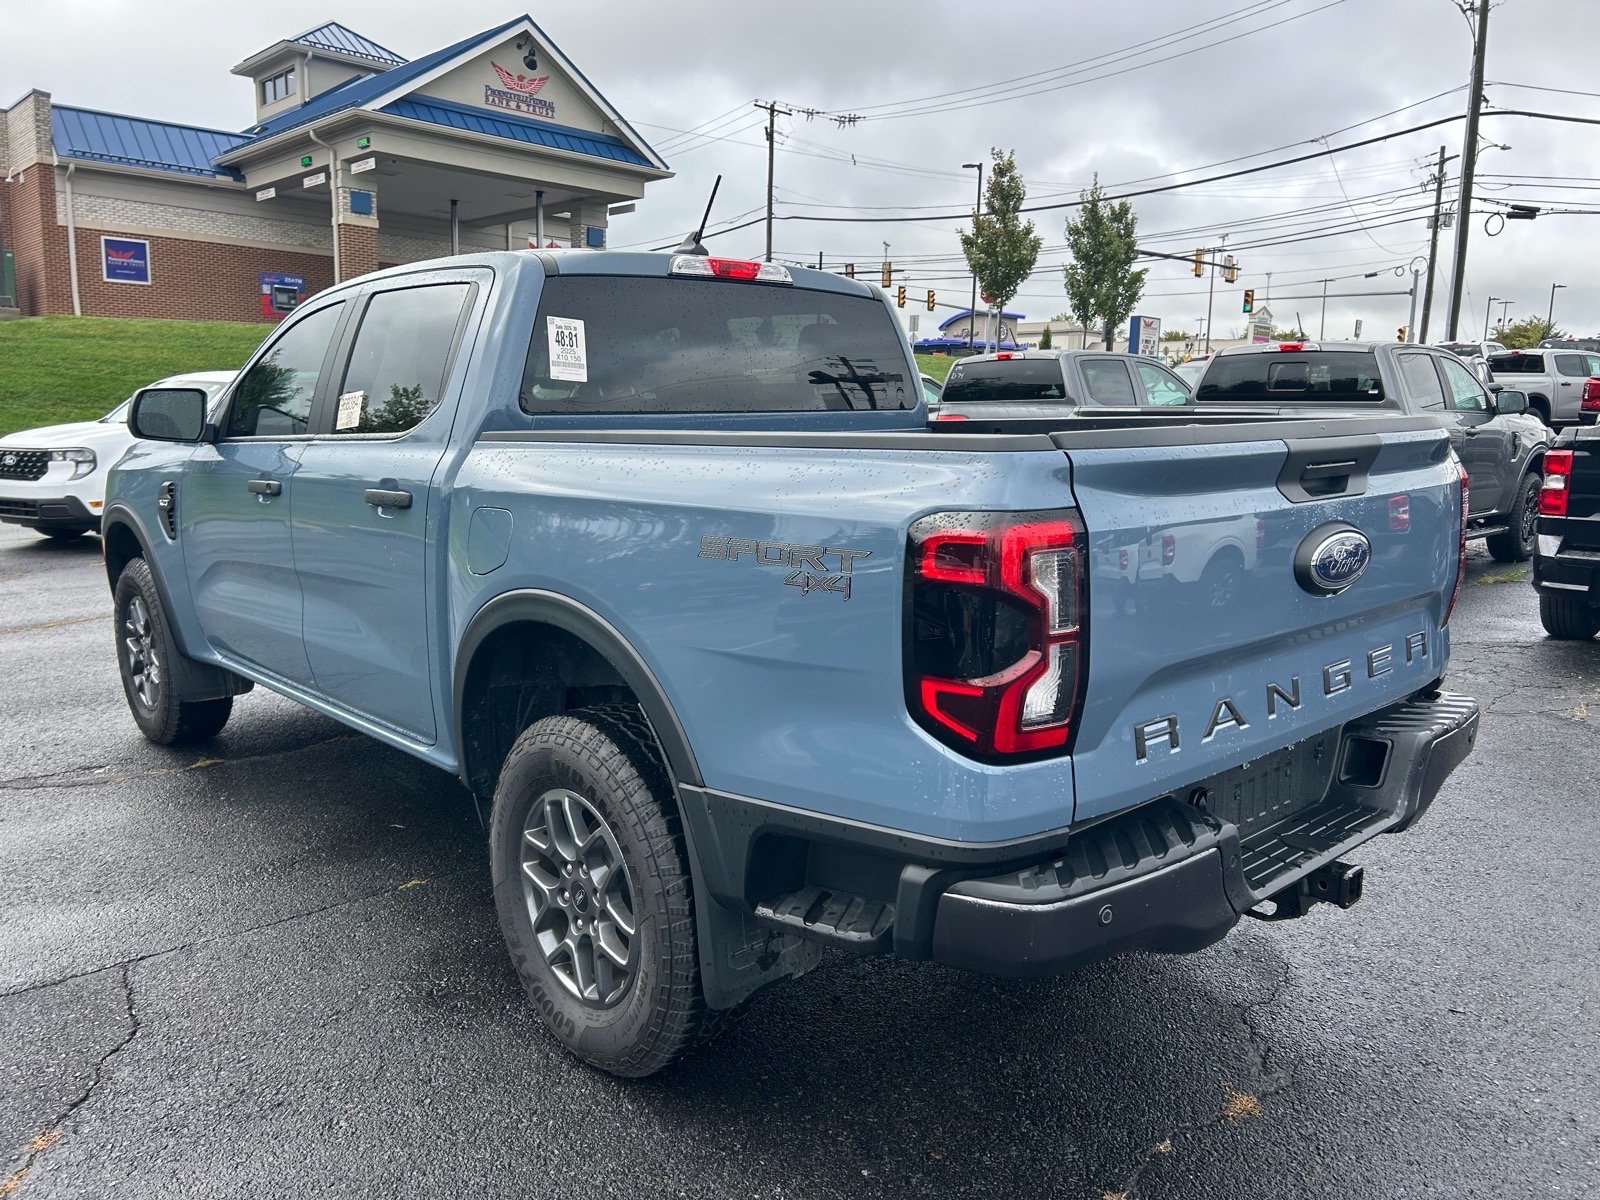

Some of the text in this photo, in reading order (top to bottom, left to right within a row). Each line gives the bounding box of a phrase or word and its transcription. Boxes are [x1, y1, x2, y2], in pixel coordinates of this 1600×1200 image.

[485, 96, 511, 107] BANK
[527, 104, 555, 116] TRUST
[555, 330, 578, 348] 48:81
[698, 535, 872, 574] SPORT
[1329, 544, 1364, 577] Ford
[1134, 630, 1428, 766] RANGER
